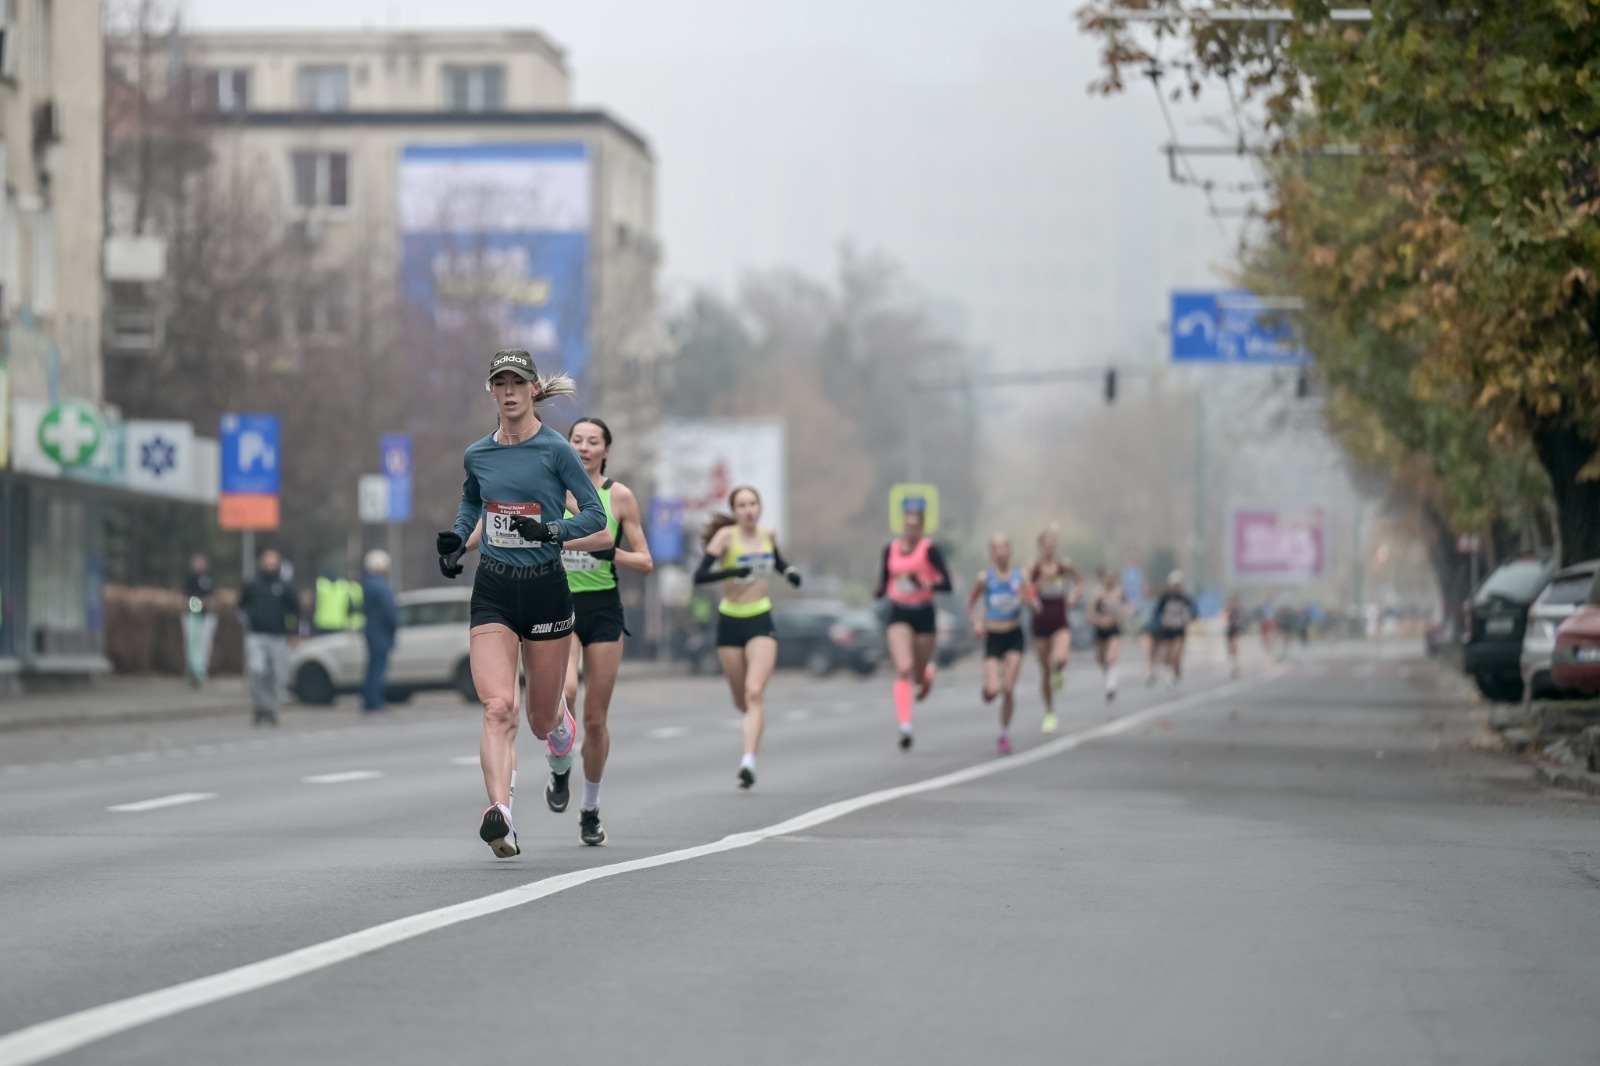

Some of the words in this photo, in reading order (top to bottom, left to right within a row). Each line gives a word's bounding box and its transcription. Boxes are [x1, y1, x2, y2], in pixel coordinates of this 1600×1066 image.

[493, 354, 527, 367] adidas
[480, 555, 506, 575] PRO
[511, 561, 550, 579] NIKE
